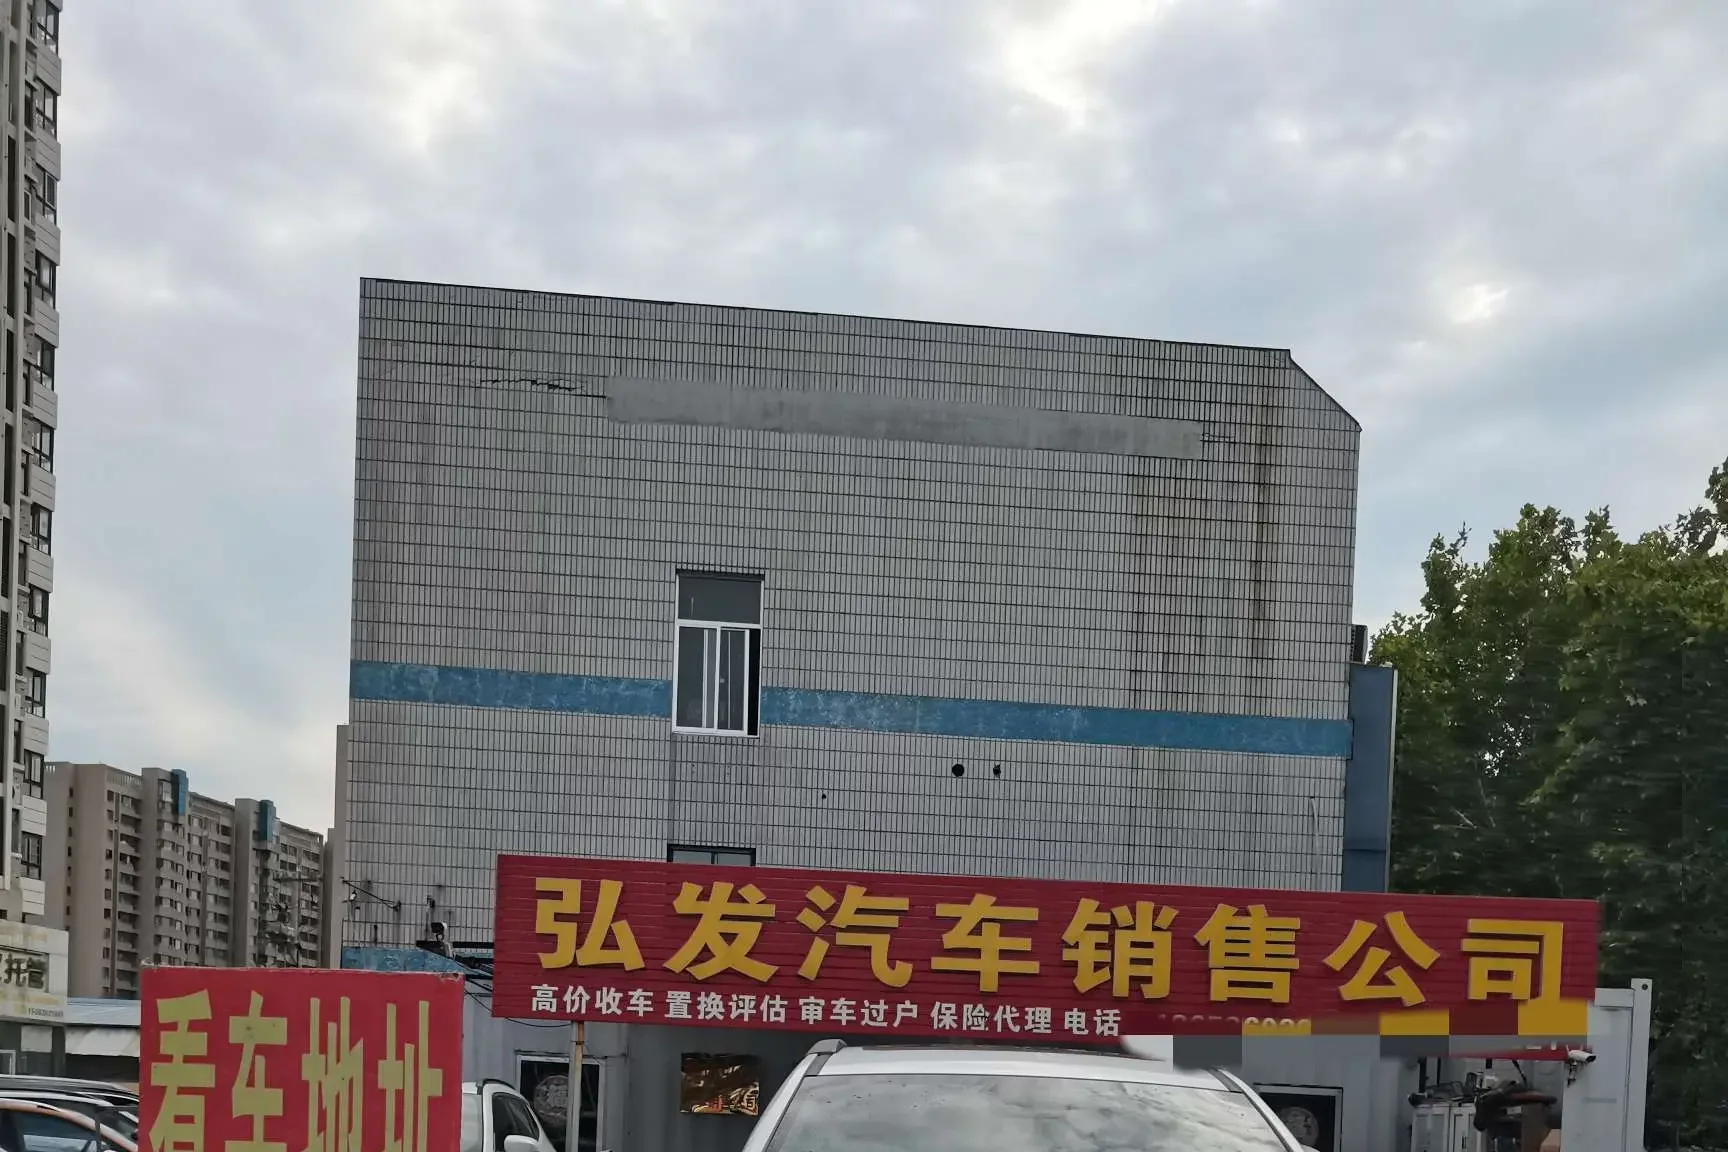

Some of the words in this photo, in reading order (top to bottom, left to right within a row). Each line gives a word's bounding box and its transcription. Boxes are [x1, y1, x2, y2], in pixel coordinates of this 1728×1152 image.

[533, 877, 1564, 1007] 弘发汽车销售公司
[531, 984, 654, 1018] 高价收车
[665, 989, 788, 1024] 置换评估
[799, 996, 919, 1029] 审车过户
[931, 1001, 1052, 1034] 保险代理
[1063, 1007, 1122, 1037] 电话
